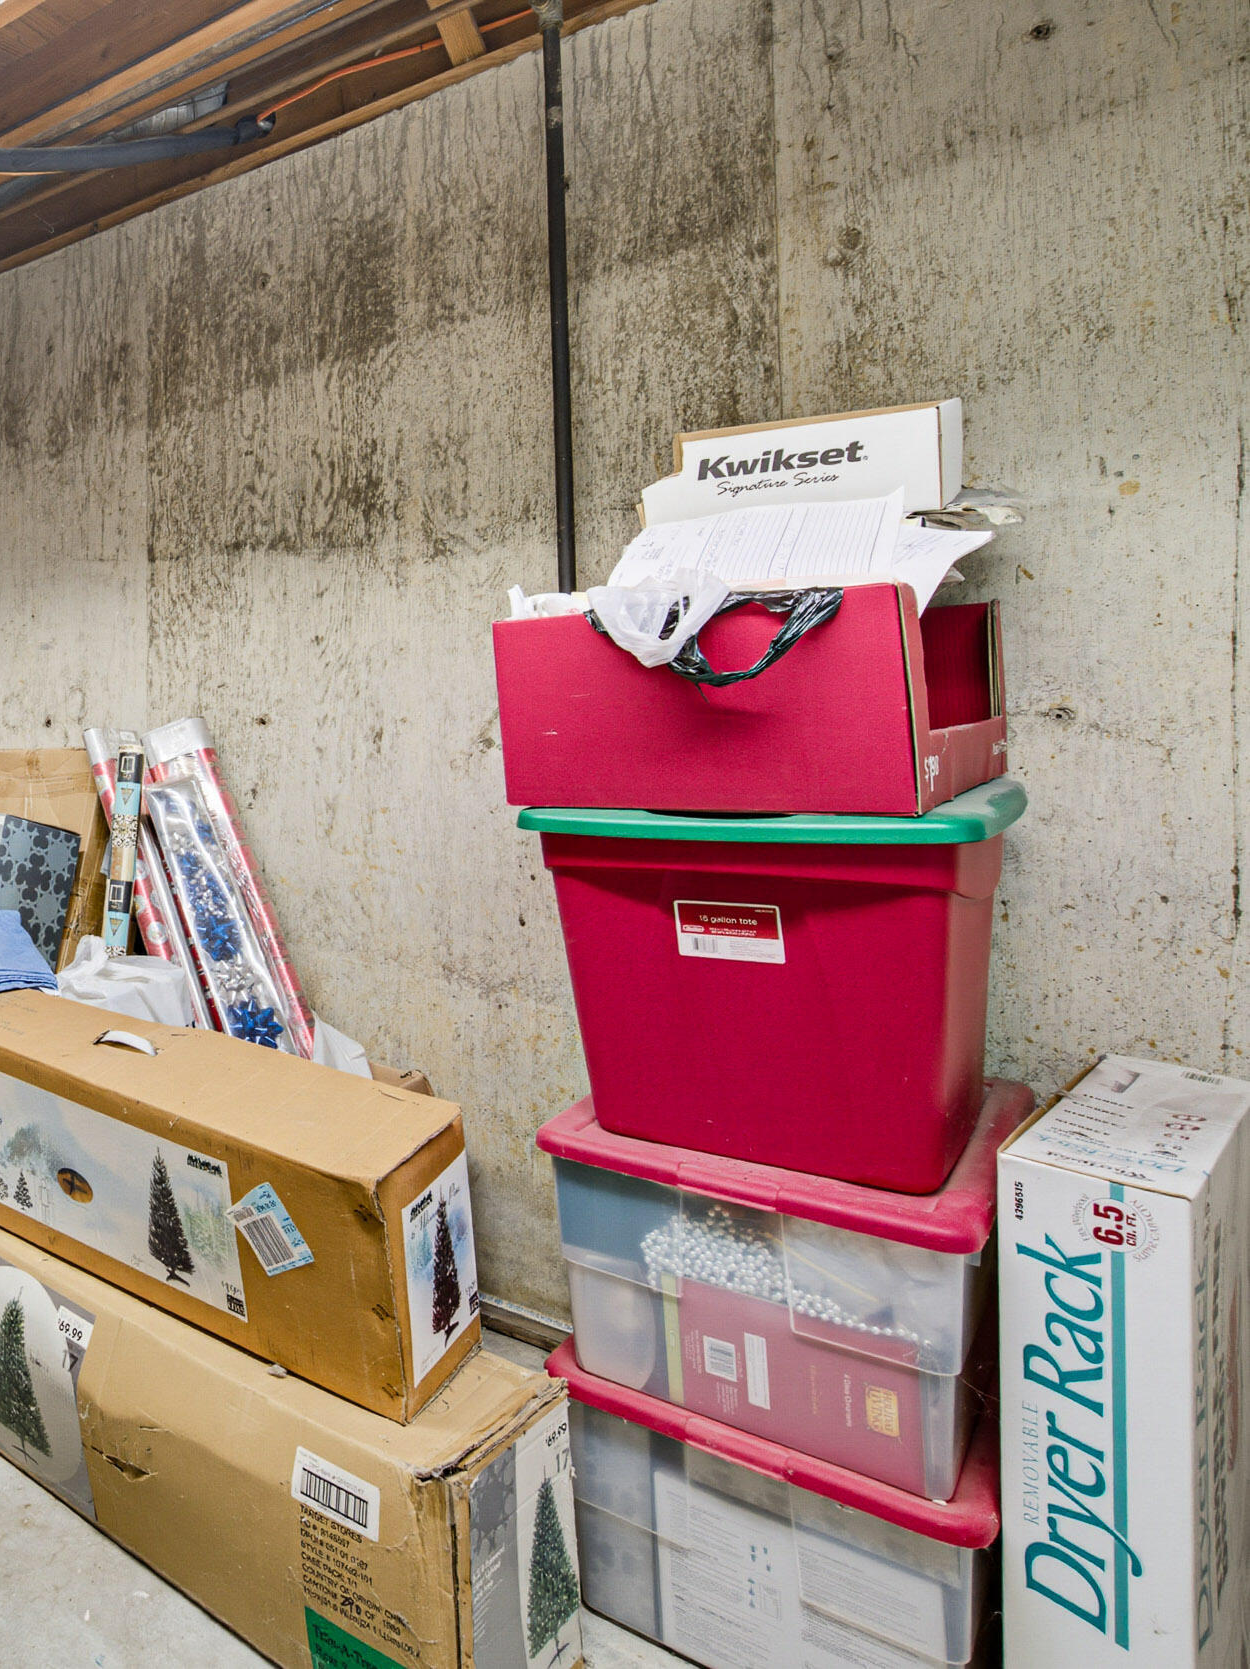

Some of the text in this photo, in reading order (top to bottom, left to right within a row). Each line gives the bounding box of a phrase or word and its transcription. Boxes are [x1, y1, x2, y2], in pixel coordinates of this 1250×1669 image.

[697, 440, 864, 481] Kwikset
[717, 471, 840, 498] Signature Series
[710, 916, 737, 924] gallon
[739, 918, 758, 926] tote
[1093, 1202, 1125, 1246] 6.5
[1015, 1232, 1106, 1418] Rack
[556, 1448, 570, 1473] 17
[1022, 1399, 1041, 1528] REMOVABLE
[300, 1505, 363, 1543] TARGET STORES
[1025, 1409, 1142, 1635] Dryer
[300, 1540, 324, 1559] STYLE
[301, 1551, 322, 1570] CASE
[302, 1562, 339, 1590] COUNTRY
